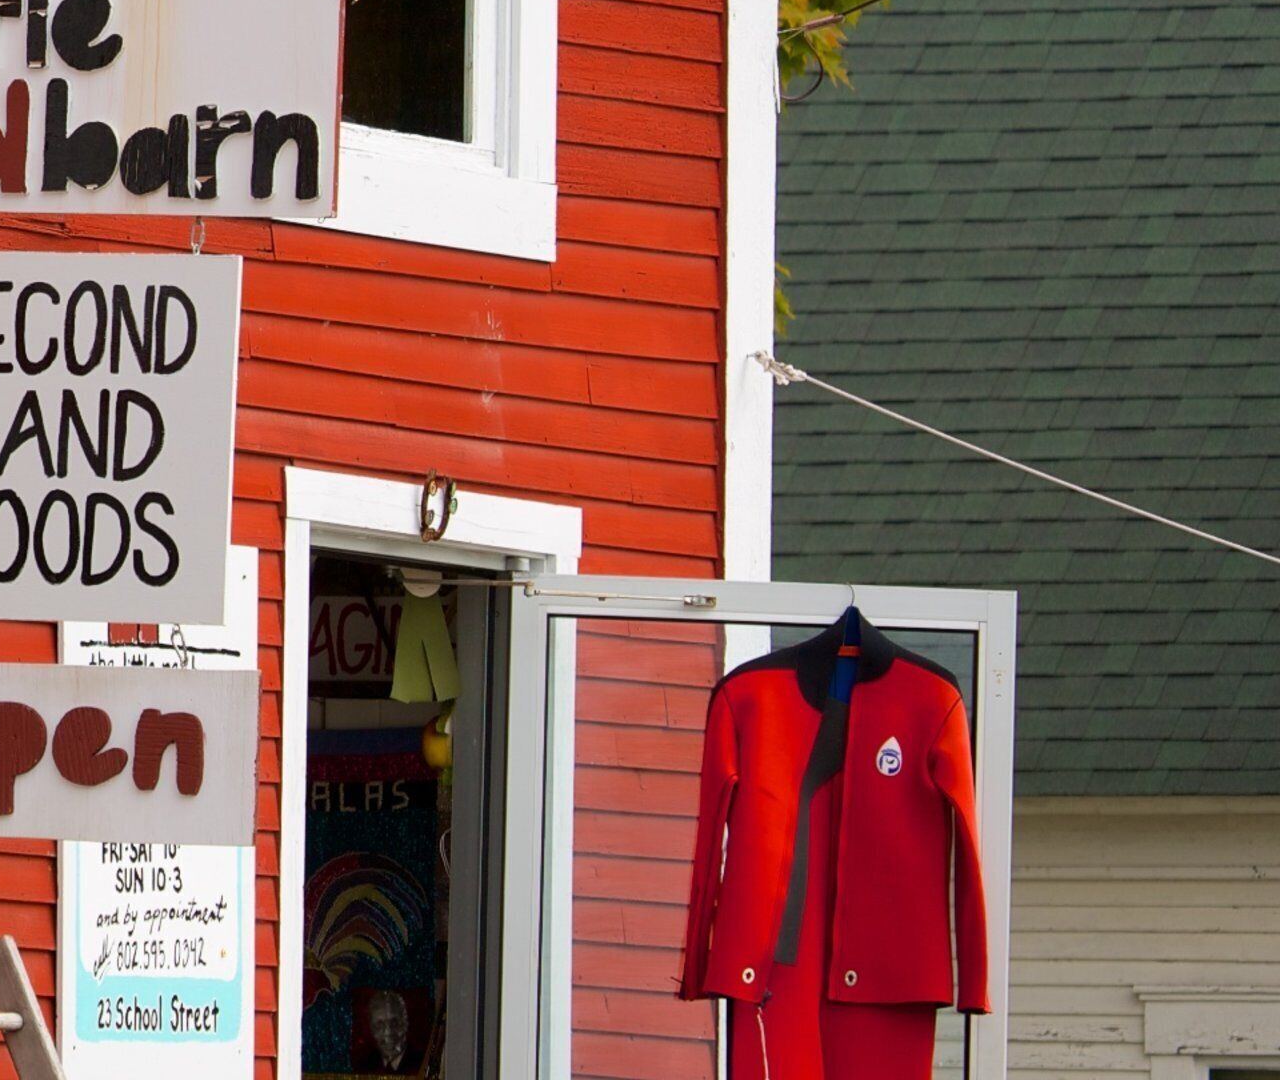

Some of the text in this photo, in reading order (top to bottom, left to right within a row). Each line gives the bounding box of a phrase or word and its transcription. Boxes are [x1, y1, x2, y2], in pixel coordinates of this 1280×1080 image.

[115, 867, 144, 894] SUN
[96, 894, 228, 937] and by appointment
[116, 937, 207, 971] 802.595.0342
[97, 994, 220, 1033] 23 School Street
